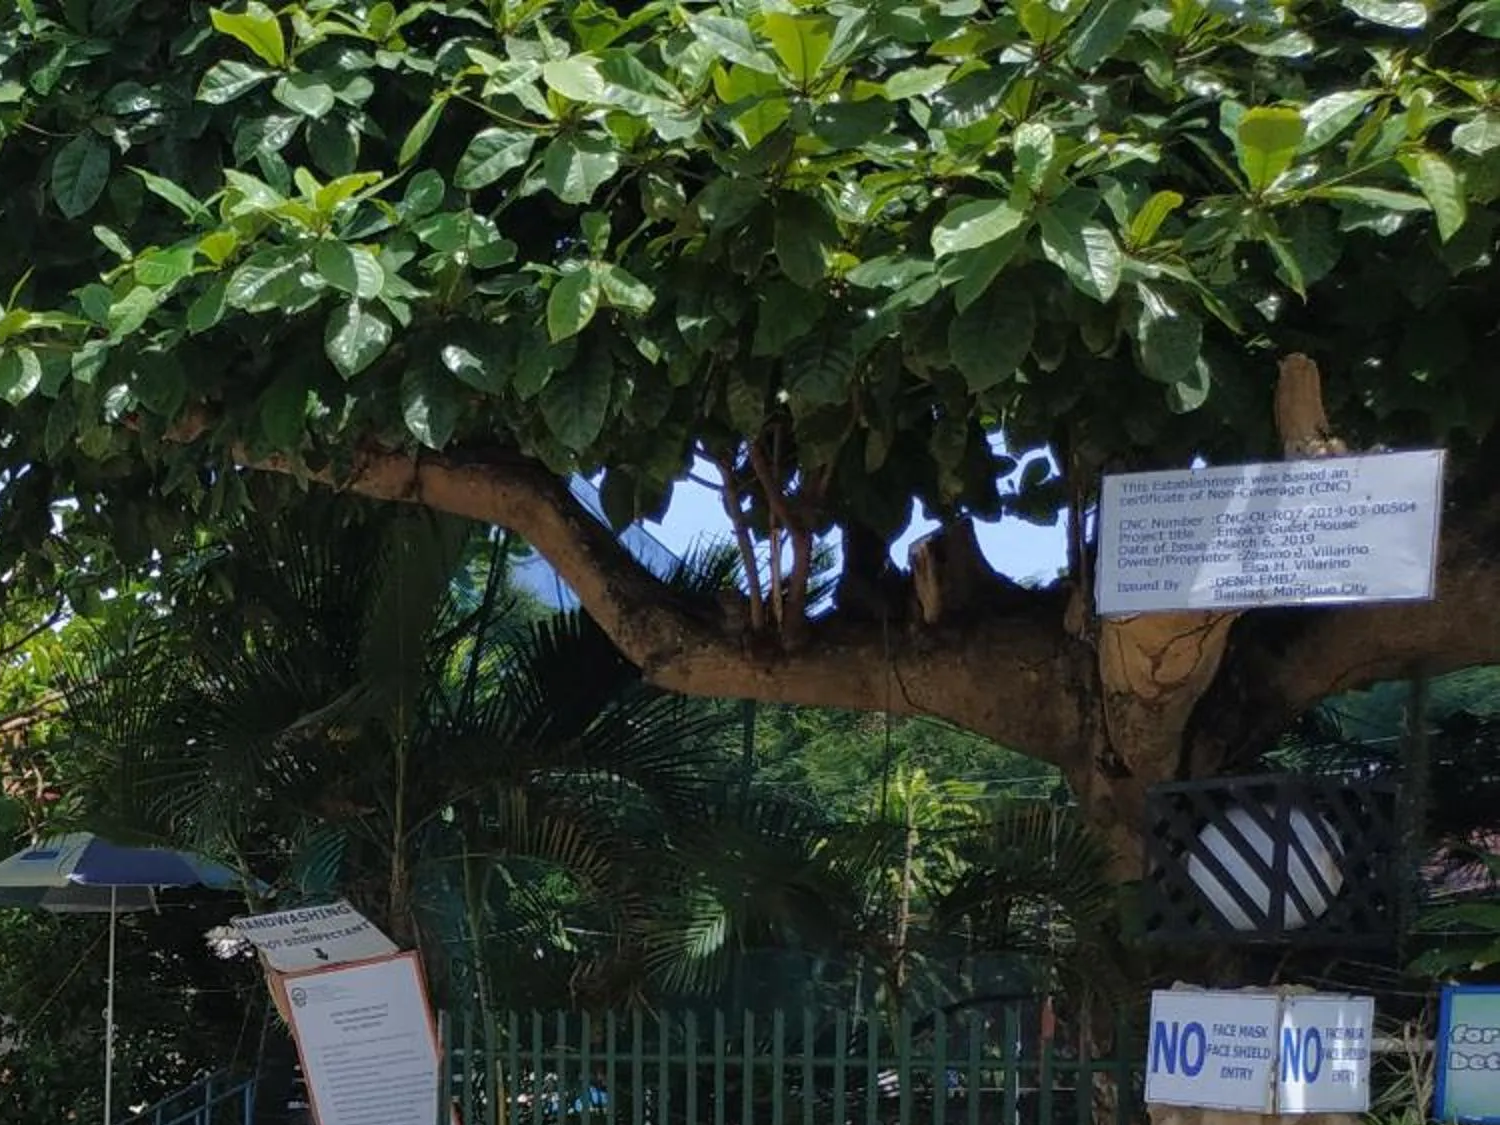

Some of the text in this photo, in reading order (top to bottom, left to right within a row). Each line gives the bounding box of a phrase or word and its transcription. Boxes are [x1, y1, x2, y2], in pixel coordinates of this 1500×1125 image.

[1282, 468, 1327, 482] issued
[1330, 469, 1349, 479] an
[1309, 481, 1352, 496] (CNC)
[1151, 516, 1204, 529] Number
[1314, 518, 1359, 531] House
[1283, 533, 1316, 547] 2019
[1313, 544, 1369, 557] Villarino
[1294, 558, 1350, 571] Villarino
[1152, 1021, 1269, 1077] NO FACE MASK
[1207, 1043, 1271, 1060] FACE SHIELD
[1281, 1026, 1323, 1084] NO
[1220, 1066, 1254, 1081] ENTRY
